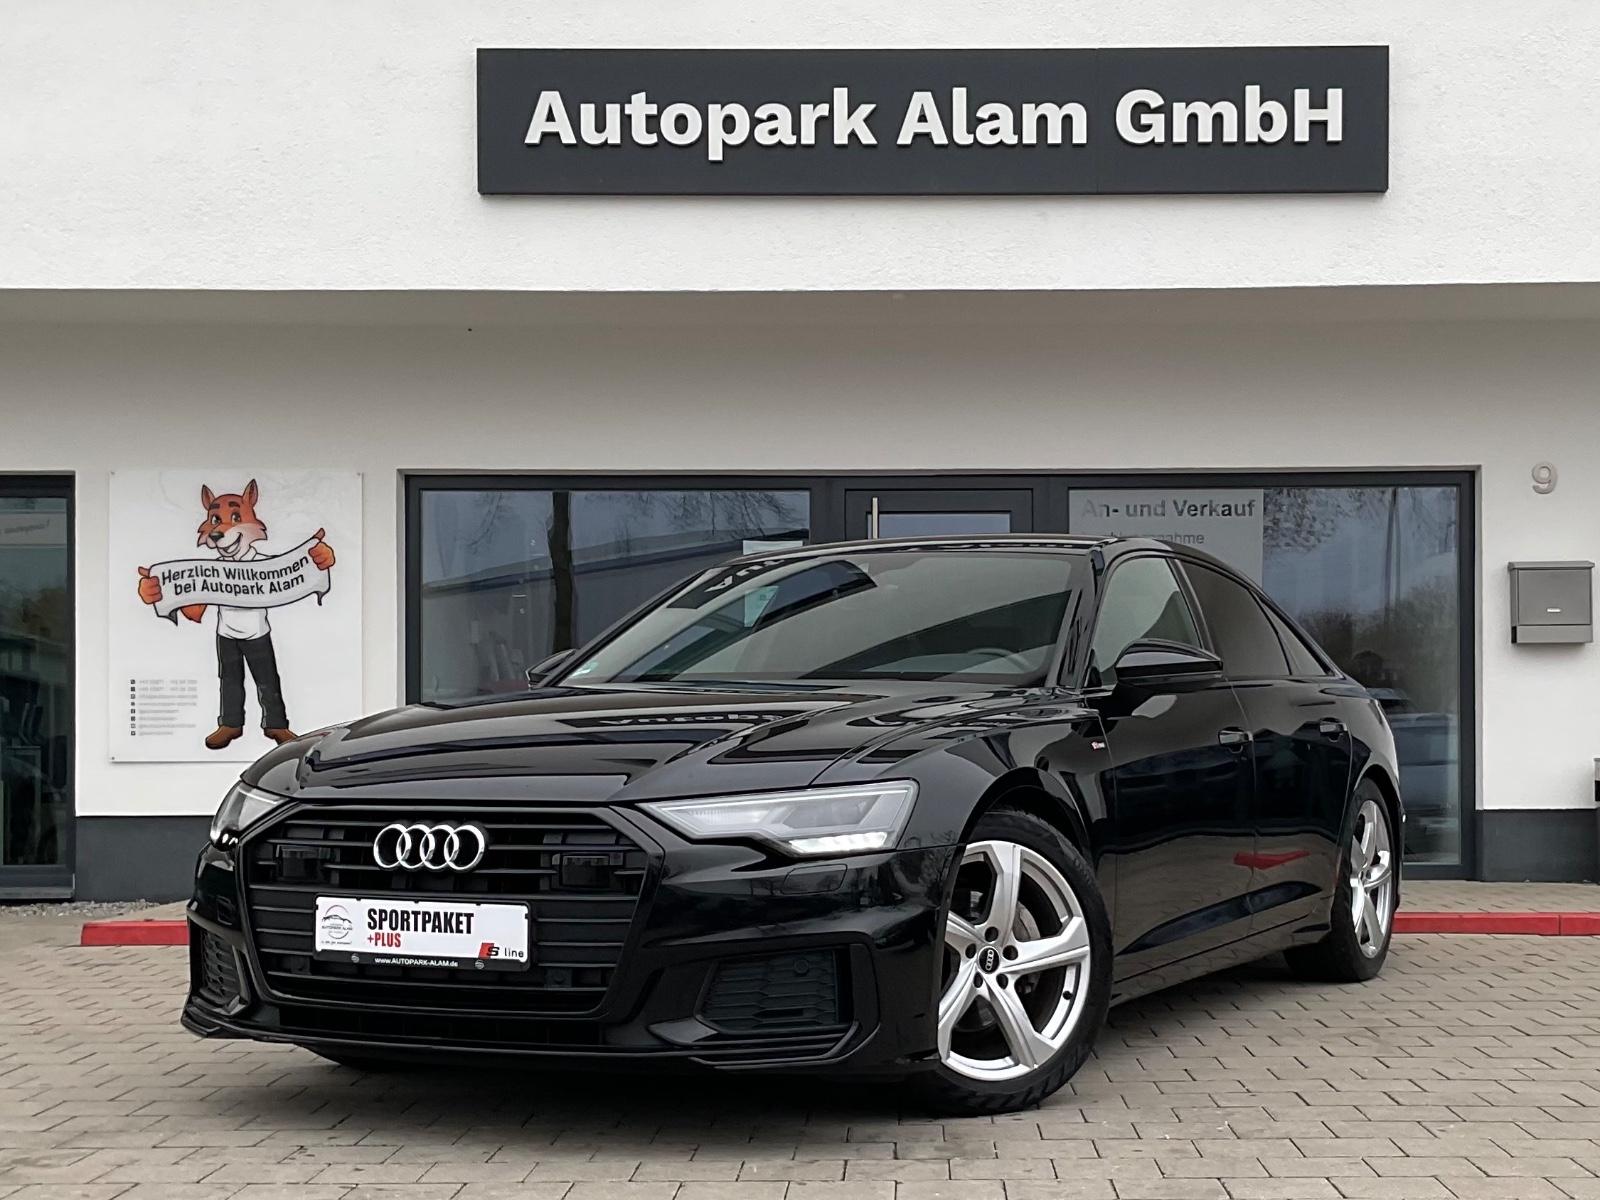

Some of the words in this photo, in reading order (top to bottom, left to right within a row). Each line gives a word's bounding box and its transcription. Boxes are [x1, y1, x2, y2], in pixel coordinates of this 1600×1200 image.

[525, 87, 878, 161] Autopark
[896, 87, 1087, 145] Alam
[1115, 84, 1343, 144] GmbH
[1531, 462, 1558, 494] 9
[1082, 499, 1119, 517] An-
[1125, 499, 1166, 518] und
[1172, 498, 1257, 518] Verkauf
[162, 565, 220, 586] Herzlich
[222, 556, 309, 581] Willkommen
[174, 579, 197, 596] bei
[201, 579, 265, 597] Autopark
[268, 574, 305, 595] Alam
[367, 908, 475, 935] SPORTPAKET
[367, 932, 401, 948] +PLUS
[374, 956, 459, 968] www.AUTOPARK-ALAM.de
[504, 947, 524, 958] line
